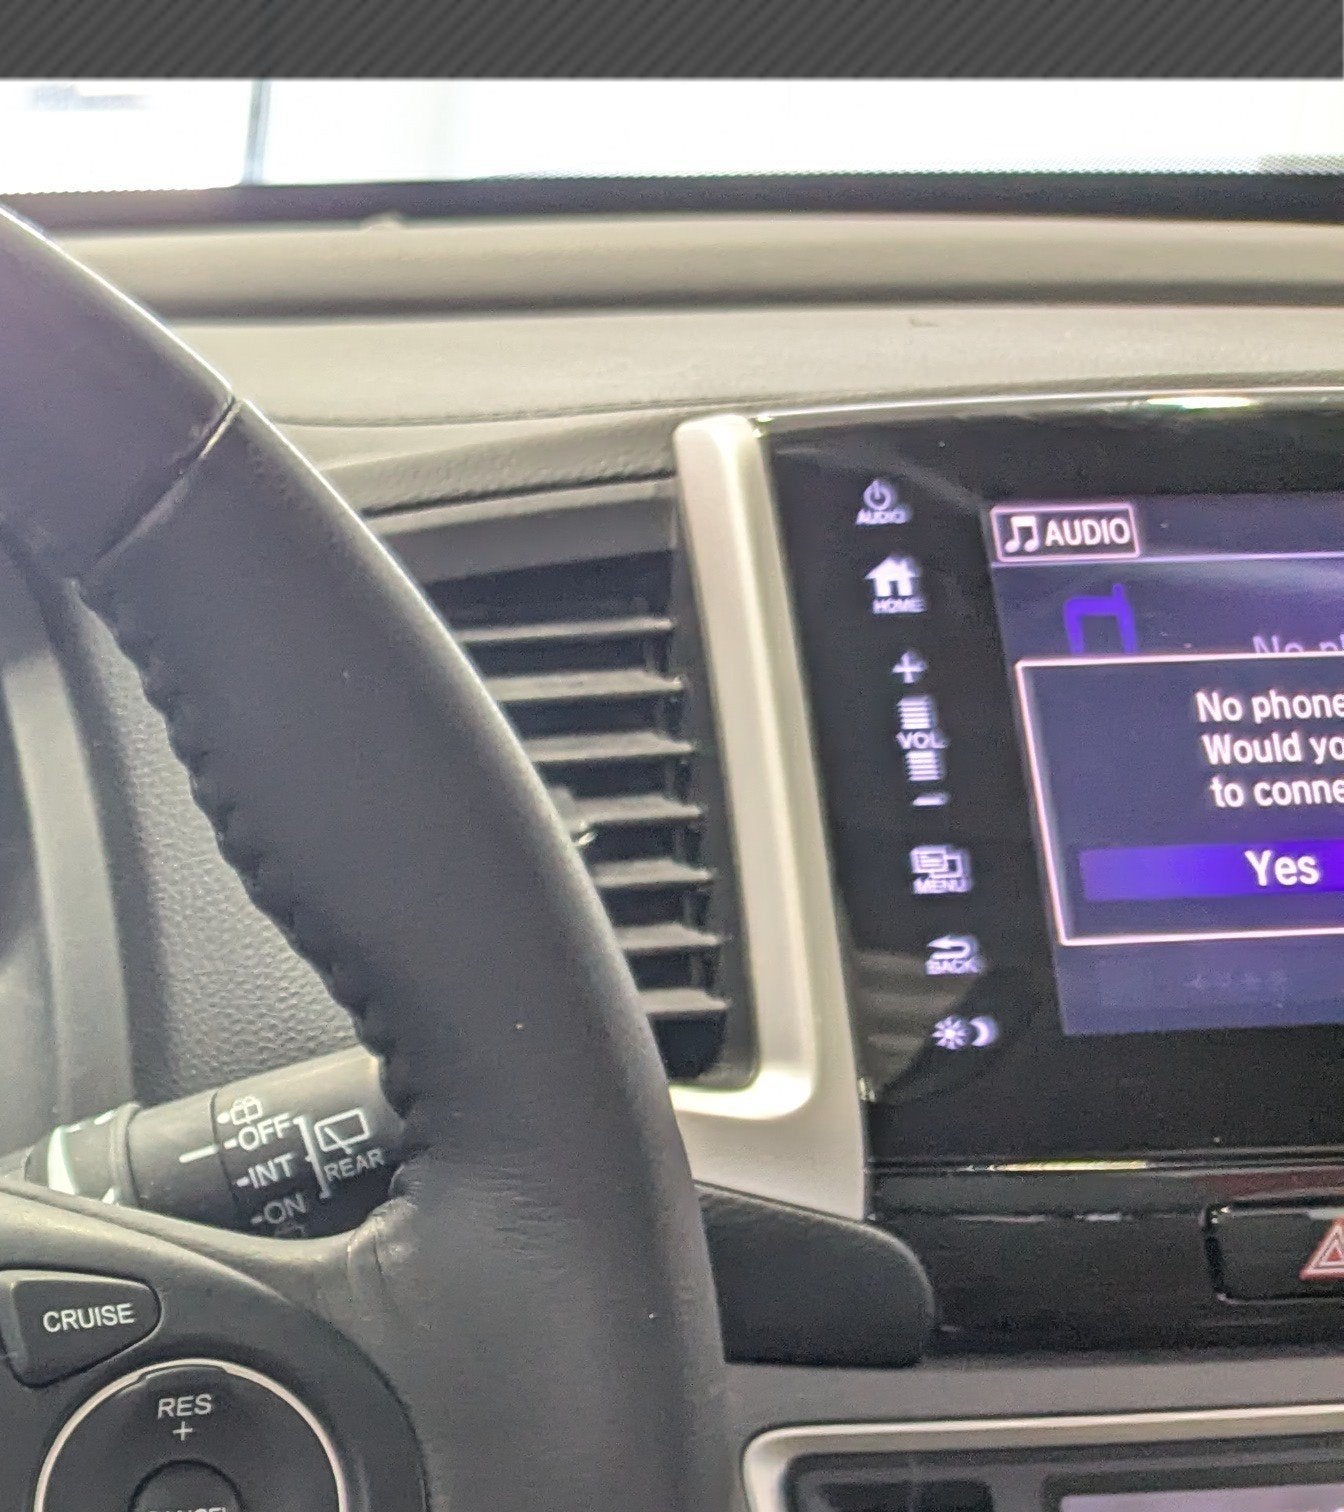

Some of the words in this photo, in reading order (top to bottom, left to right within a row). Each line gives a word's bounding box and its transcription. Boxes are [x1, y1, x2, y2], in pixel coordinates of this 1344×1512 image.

[1045, 517, 1132, 548] AUDIO
[872, 597, 926, 614] HOME
[1195, 691, 1244, 722] No
[896, 731, 946, 750] VOL
[1201, 731, 1302, 764] Would
[1210, 776, 1244, 807] to
[1245, 849, 1321, 887] Yes
[238, 1112, 292, 1151] OFF
[248, 1152, 296, 1189] INT
[323, 1149, 386, 1182] REAR
[263, 1193, 308, 1224] ON
[43, 1302, 136, 1333] CRUISE
[156, 1393, 213, 1420] RES
